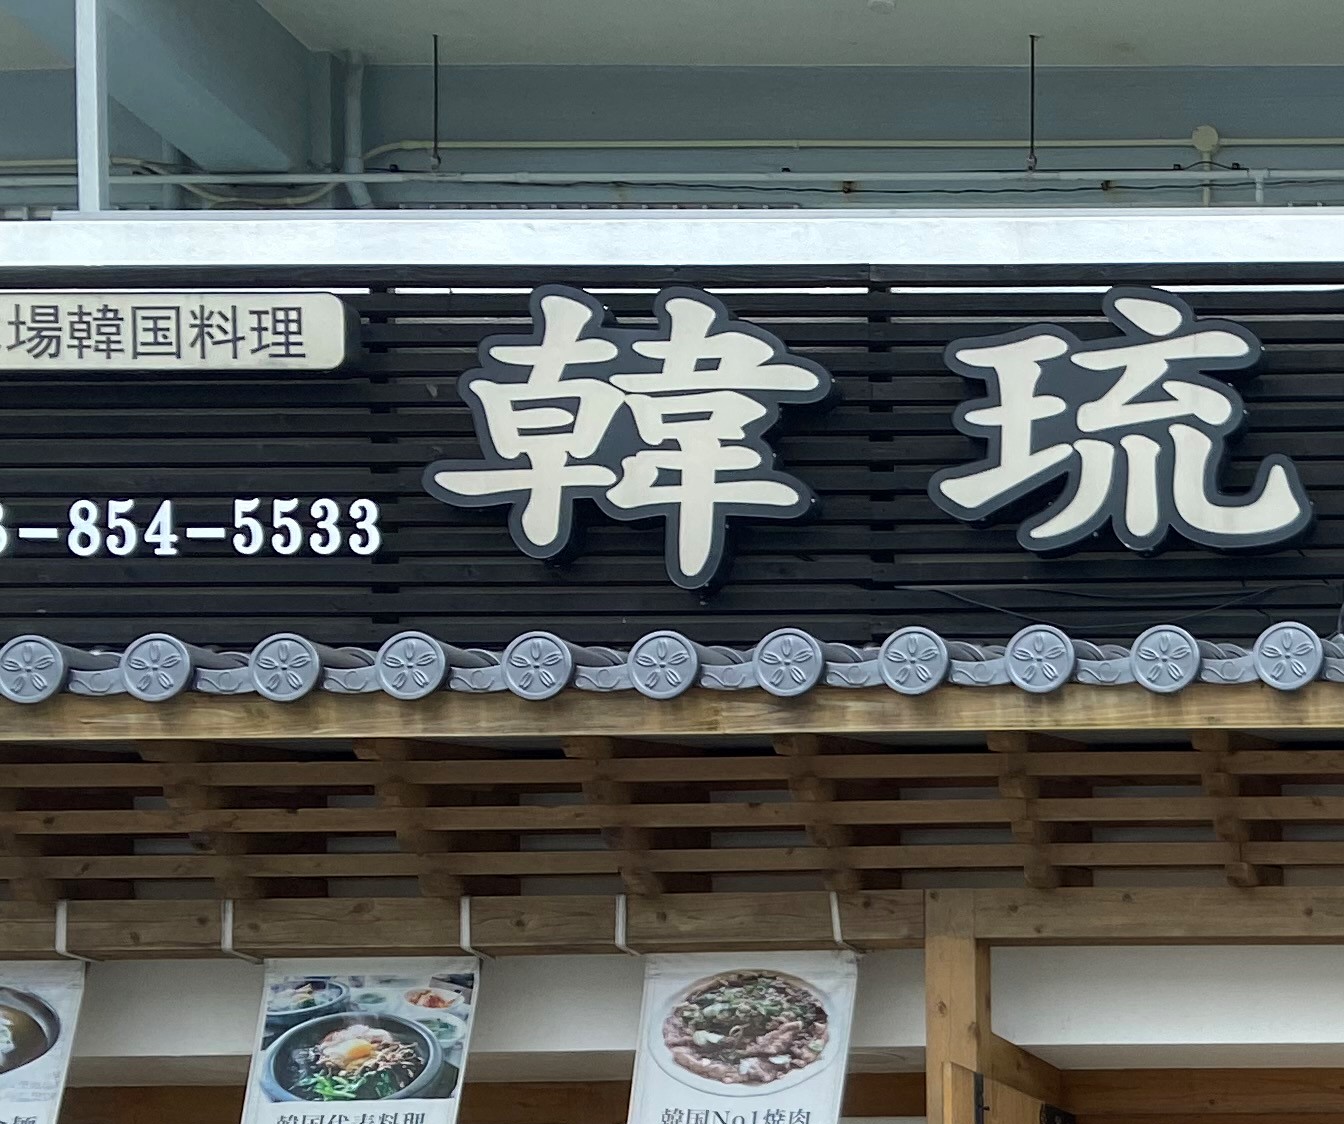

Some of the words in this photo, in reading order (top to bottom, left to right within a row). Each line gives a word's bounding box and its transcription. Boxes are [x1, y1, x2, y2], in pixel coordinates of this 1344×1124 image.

[6, 304, 308, 359] 場韓国料理
[0, 498, 381, 556] -854-5533
